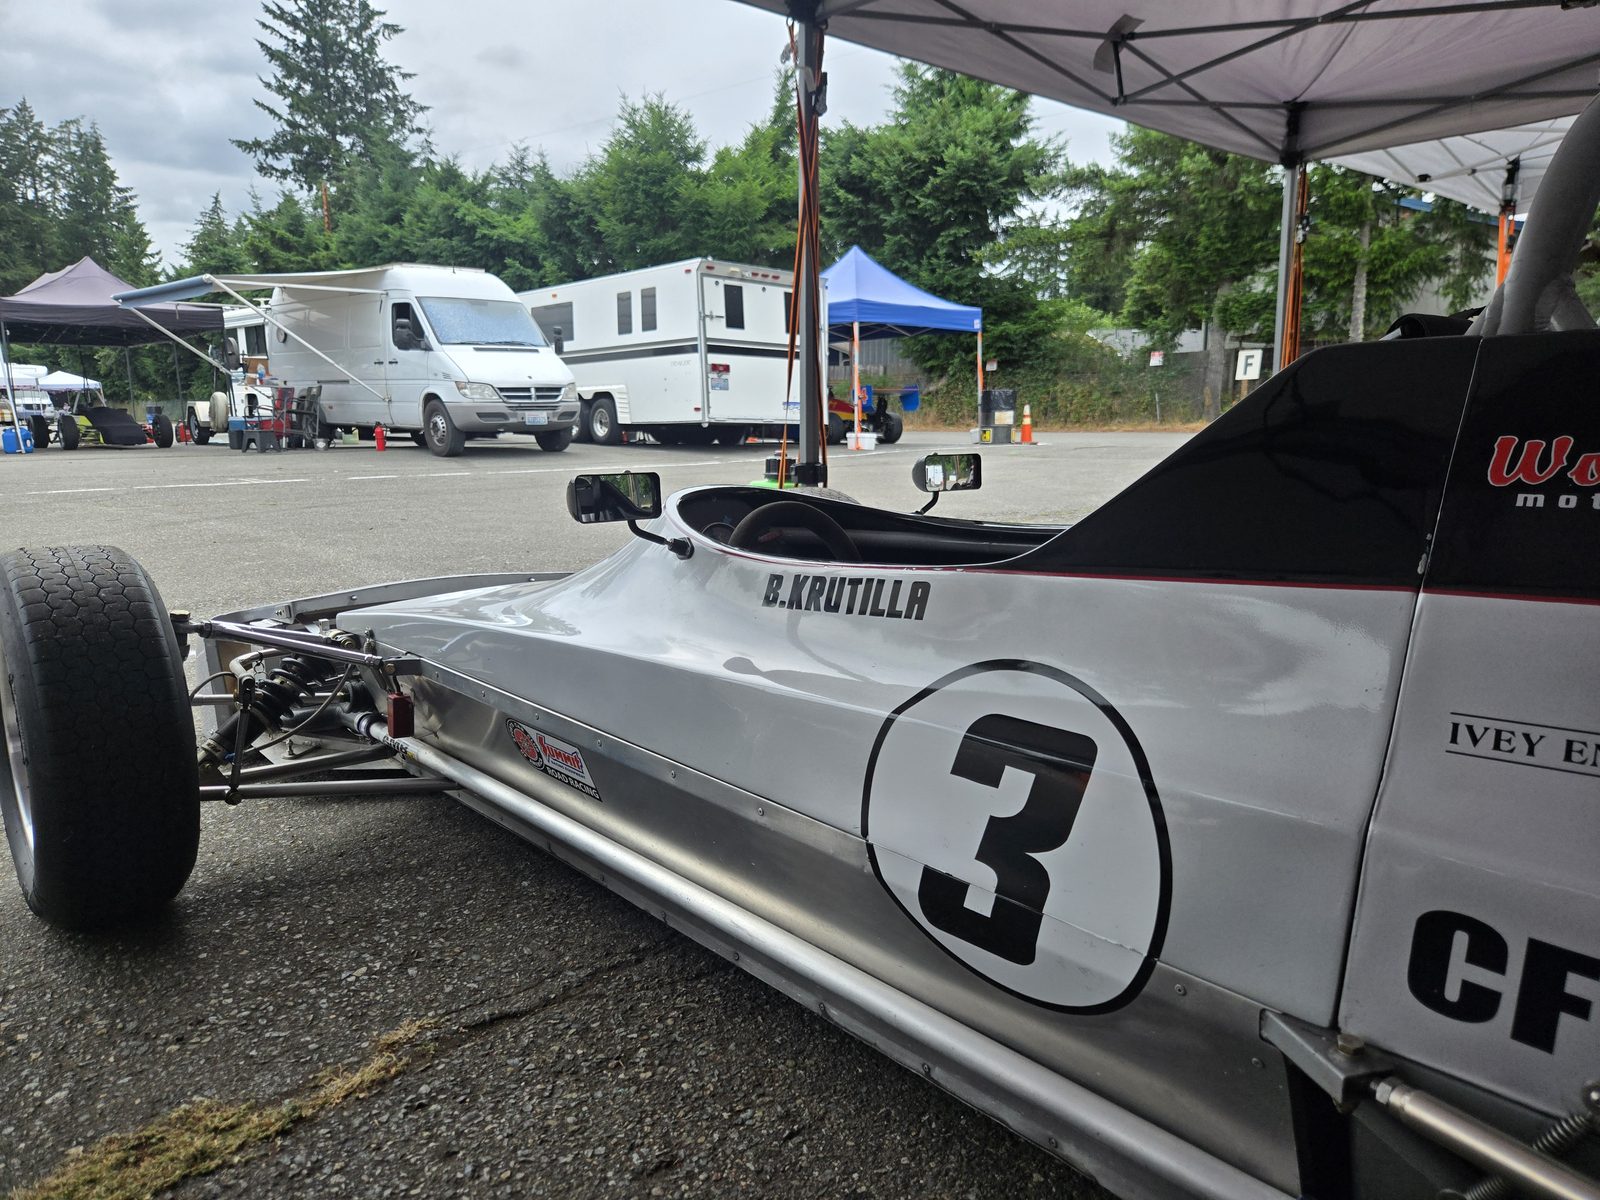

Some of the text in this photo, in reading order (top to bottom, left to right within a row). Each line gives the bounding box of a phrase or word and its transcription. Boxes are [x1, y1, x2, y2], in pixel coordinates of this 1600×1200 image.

[1243, 355, 1255, 376] F
[762, 573, 932, 621] B.KRUTILLA
[1450, 721, 1546, 757] IVEY
[569, 776, 600, 800] RACING
[918, 713, 1099, 966] 3
[1407, 909, 1600, 1055] CF
